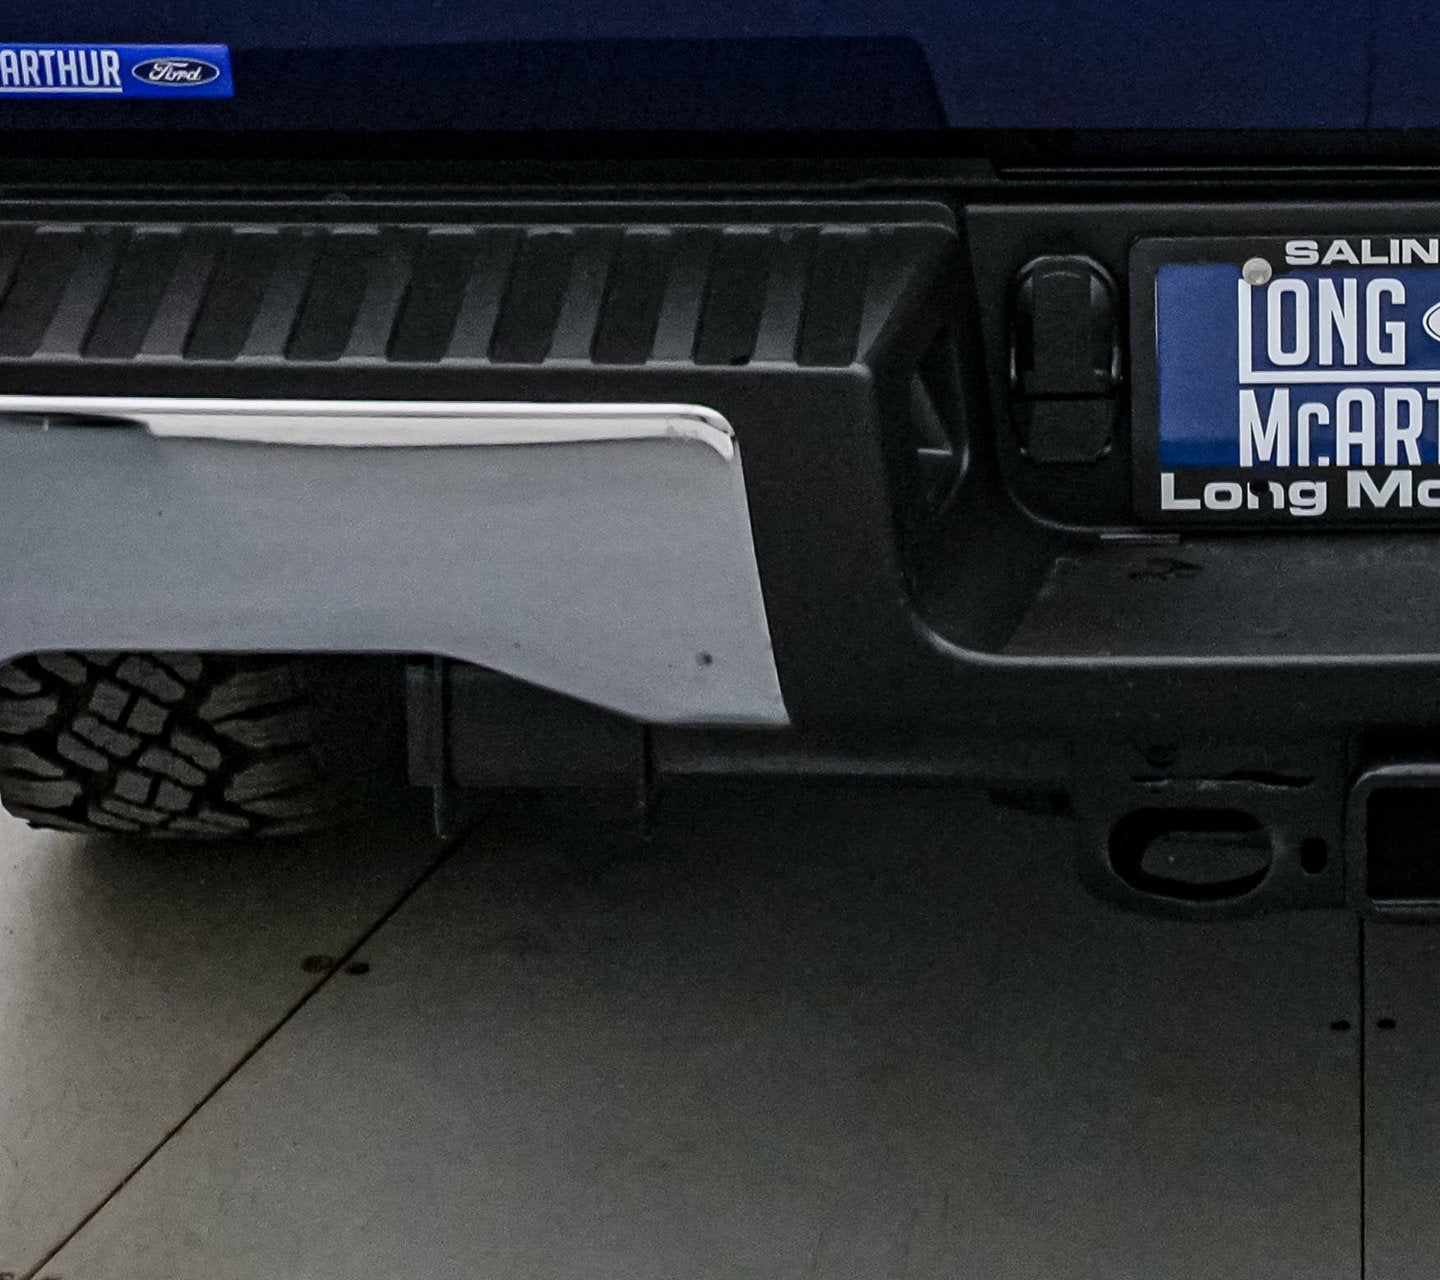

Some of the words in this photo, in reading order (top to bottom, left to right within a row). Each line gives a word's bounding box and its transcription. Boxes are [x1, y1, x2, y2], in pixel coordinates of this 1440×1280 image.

[148, 61, 202, 82] Ford
[1238, 278, 1407, 383] LONG
[1161, 472, 1328, 517] Long
